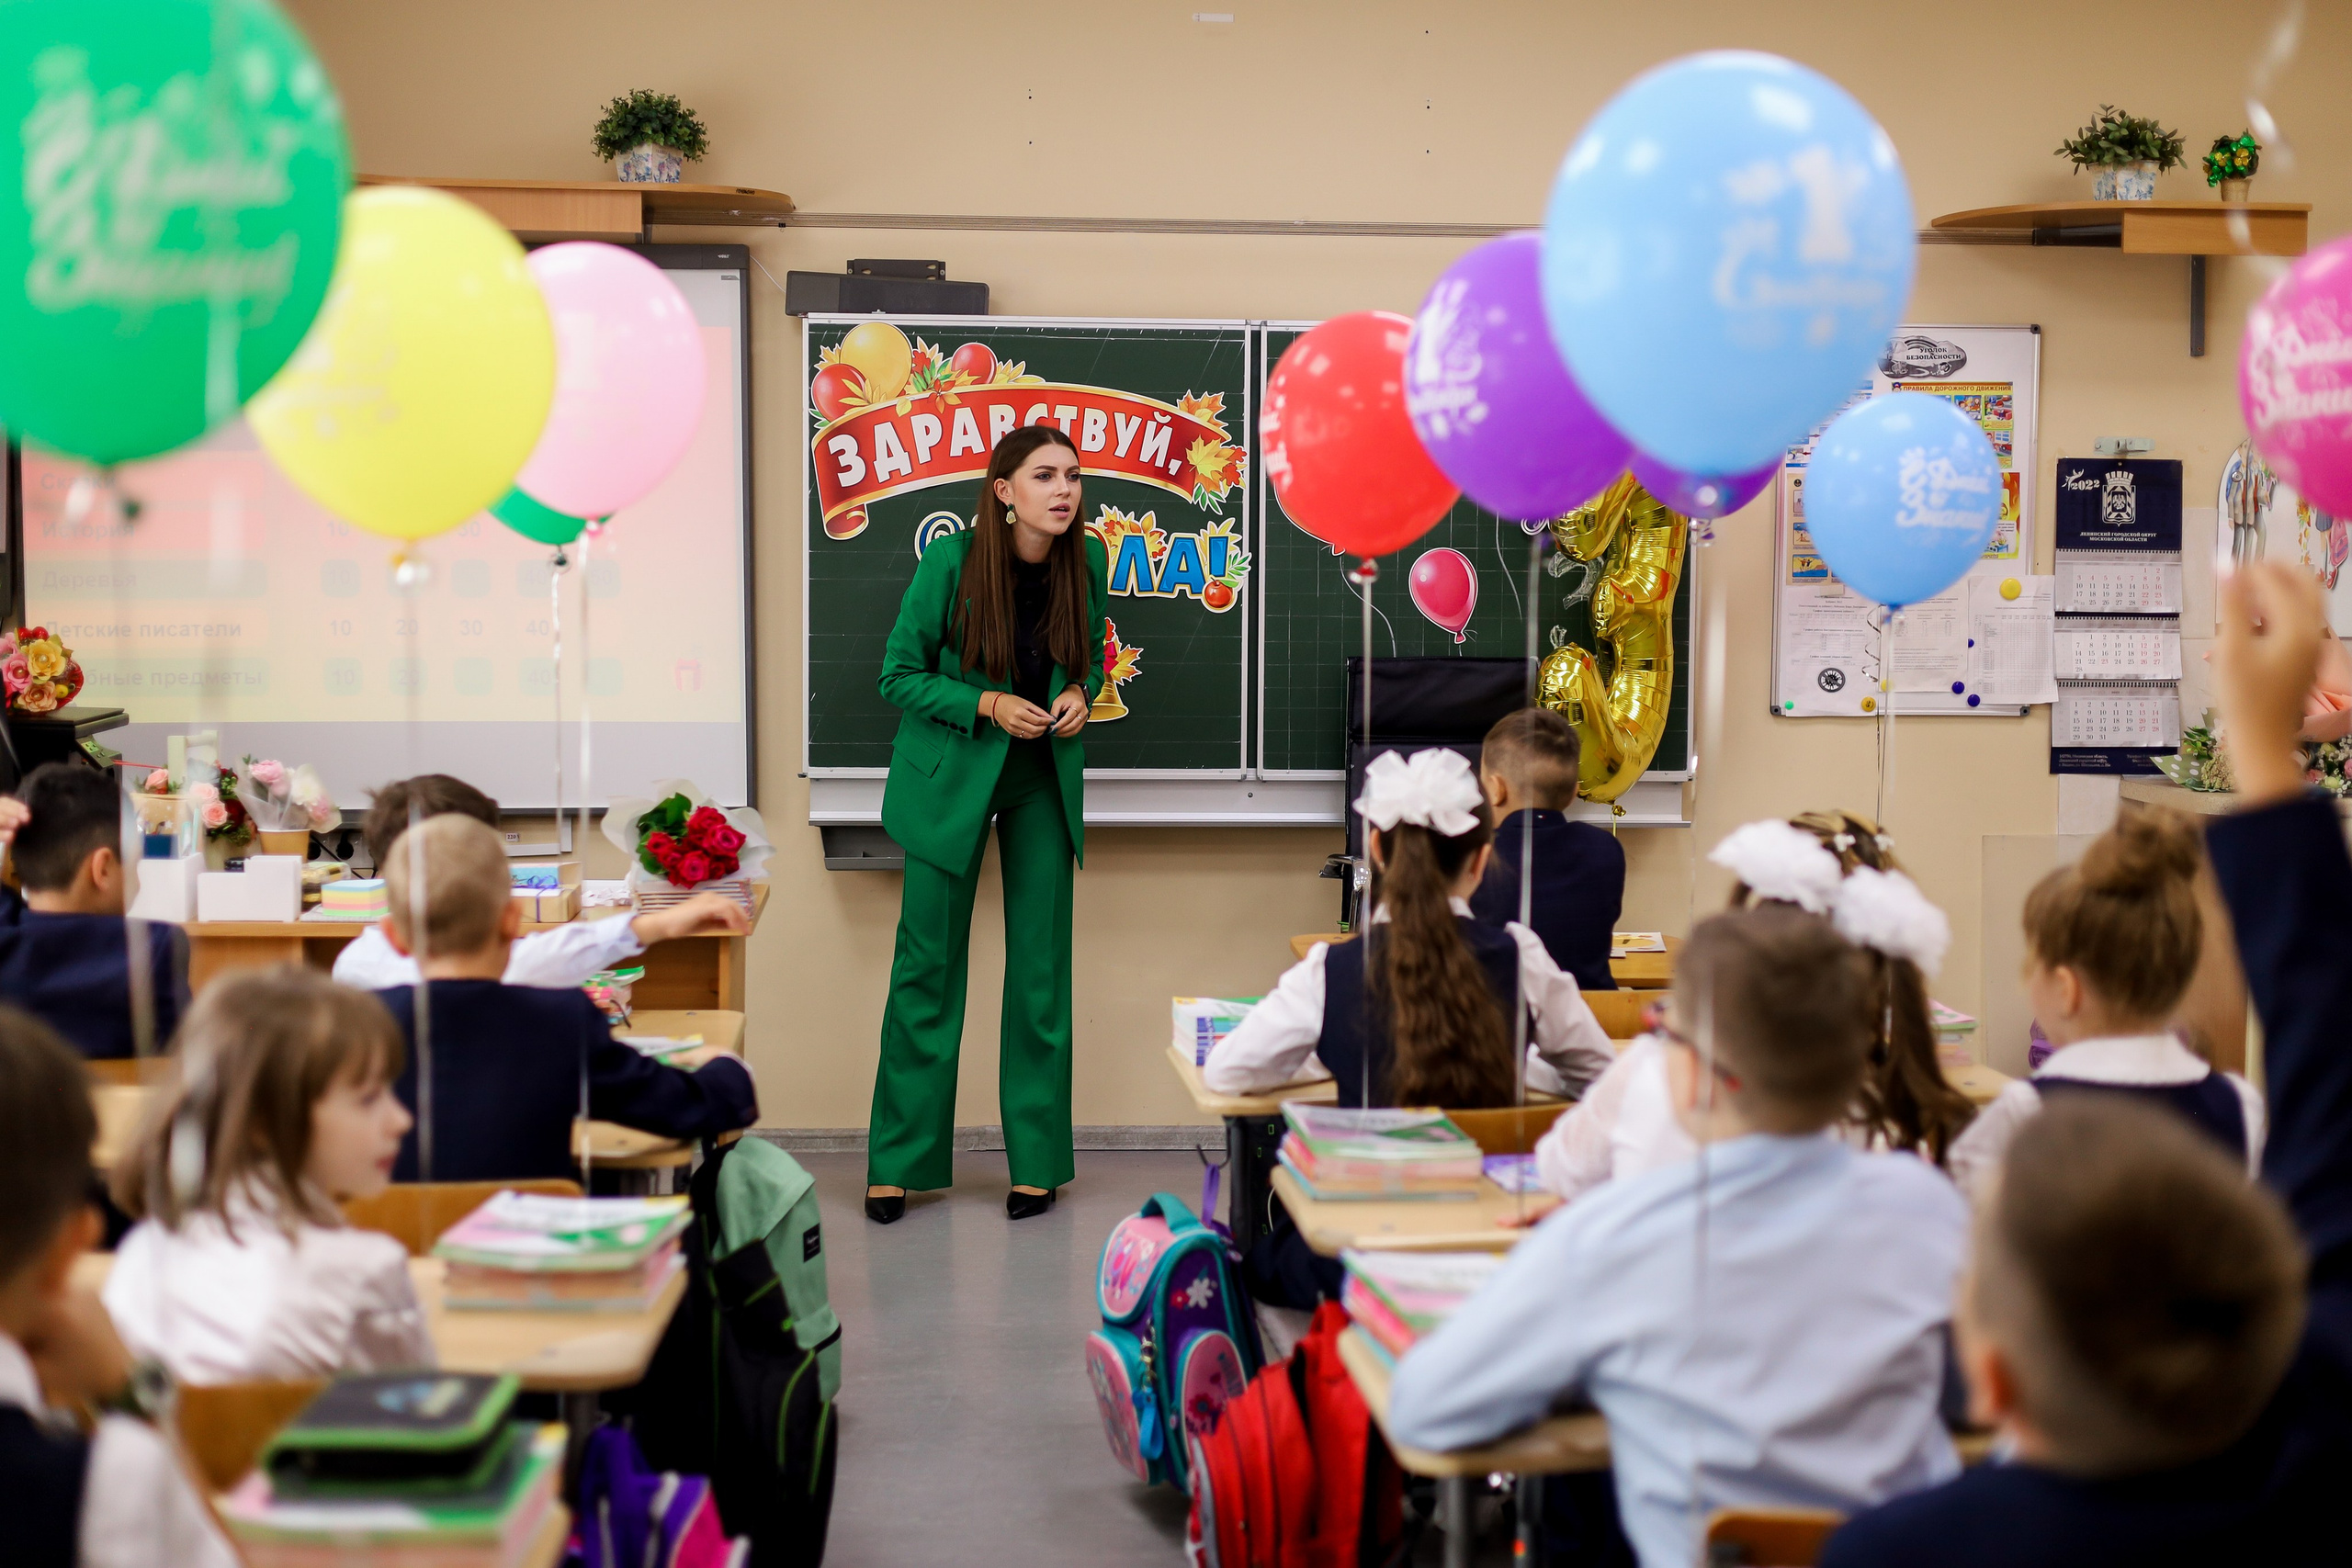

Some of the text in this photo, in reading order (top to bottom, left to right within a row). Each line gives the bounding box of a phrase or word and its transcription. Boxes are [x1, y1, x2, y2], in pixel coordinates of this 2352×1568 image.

[2071, 479, 2100, 491] 2022
[42, 570, 137, 591] Деревья
[140, 622, 242, 637] писатели
[329, 620, 353, 636] 10
[395, 619, 418, 636] 20
[459, 620, 483, 636] 30
[526, 620, 549, 636] 40
[151, 670, 262, 689] предметы
[332, 670, 355, 685] 10
[526, 670, 551, 685] 40
